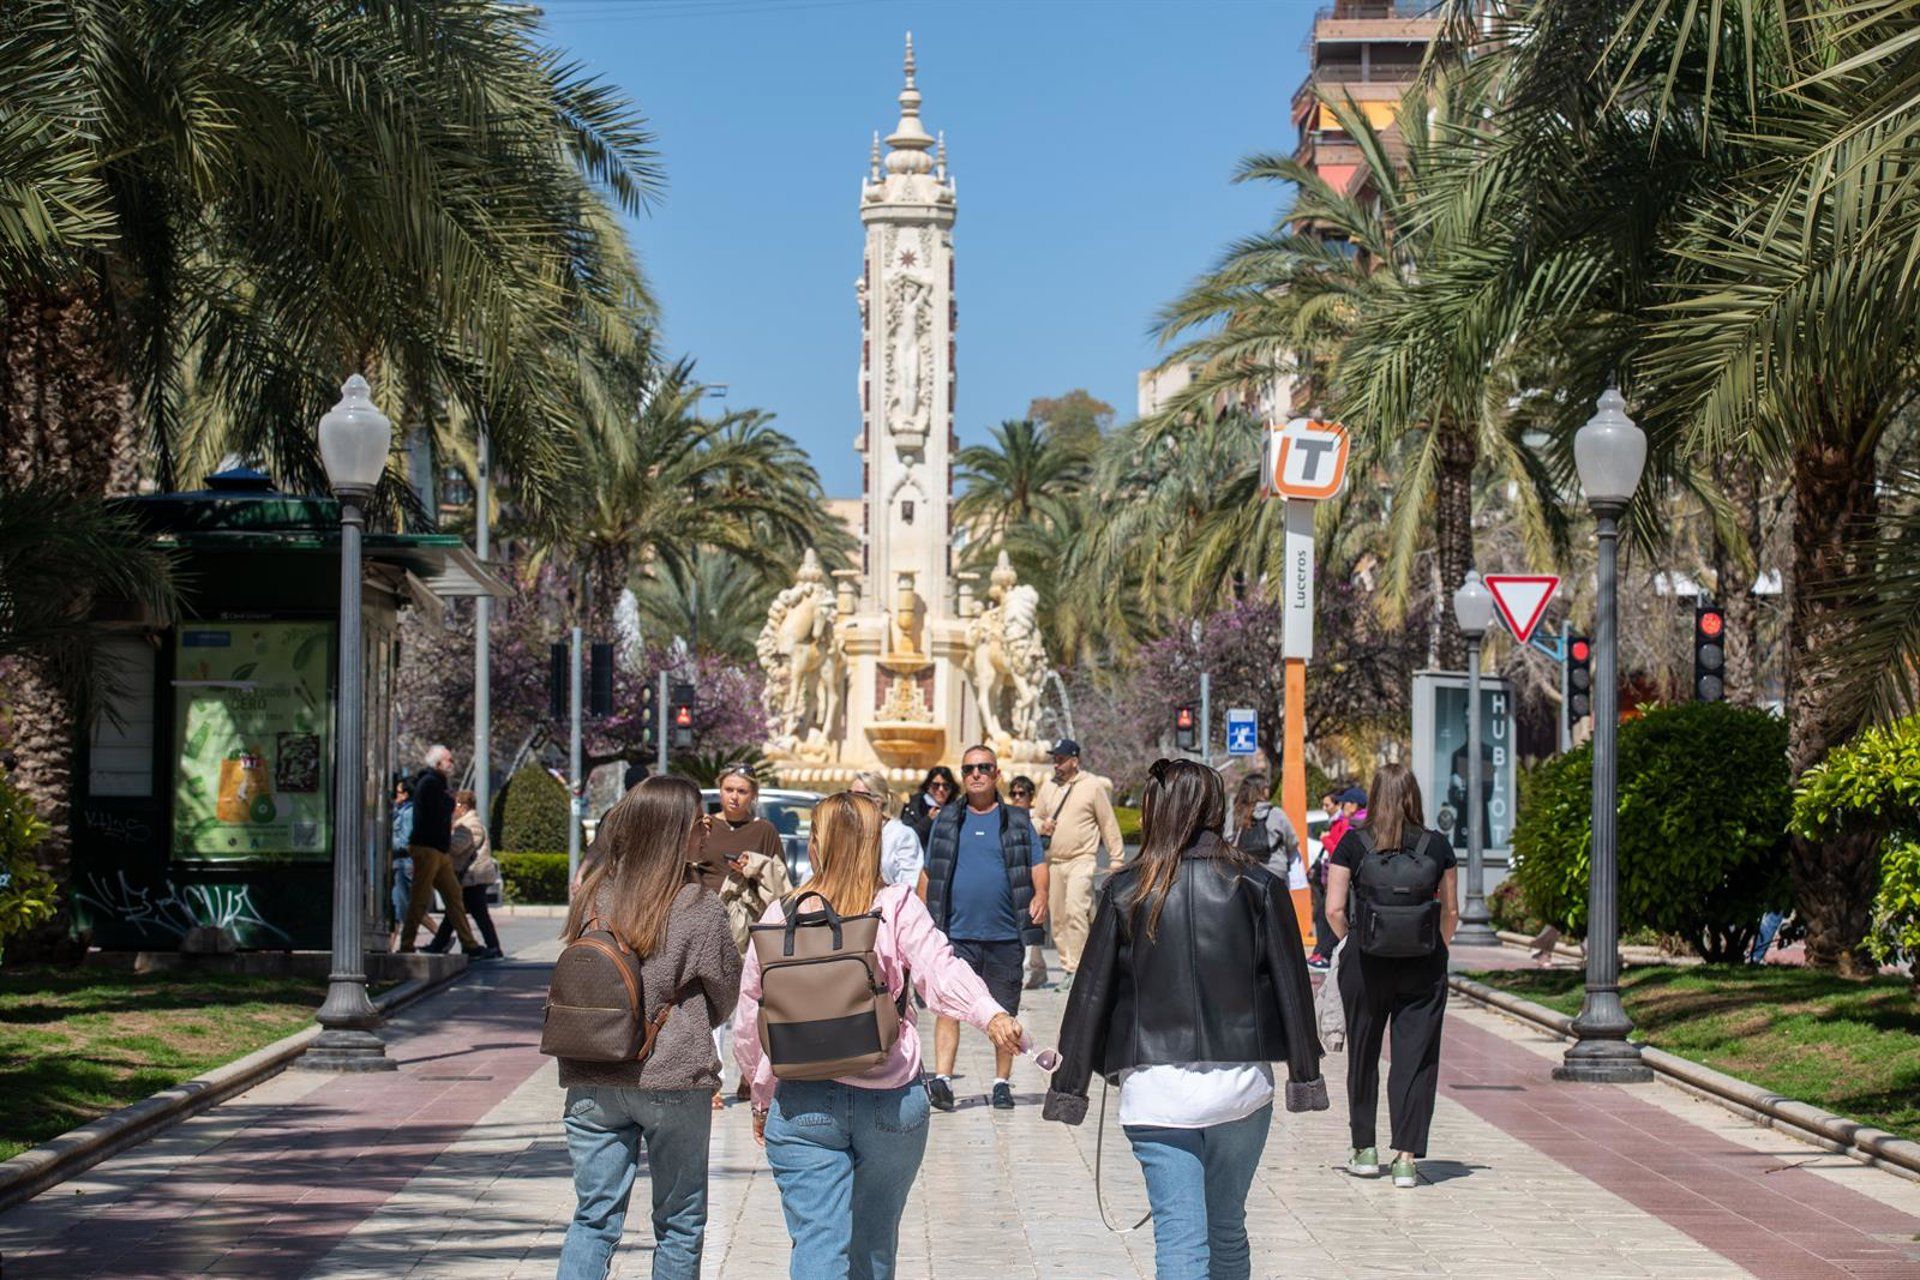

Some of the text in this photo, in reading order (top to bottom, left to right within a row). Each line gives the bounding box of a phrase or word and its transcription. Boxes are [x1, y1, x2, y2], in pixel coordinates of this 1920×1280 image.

[1295, 438, 1334, 480] T
[1293, 550, 1307, 609] Luceros
[1491, 694, 1506, 844] HUBLOT
